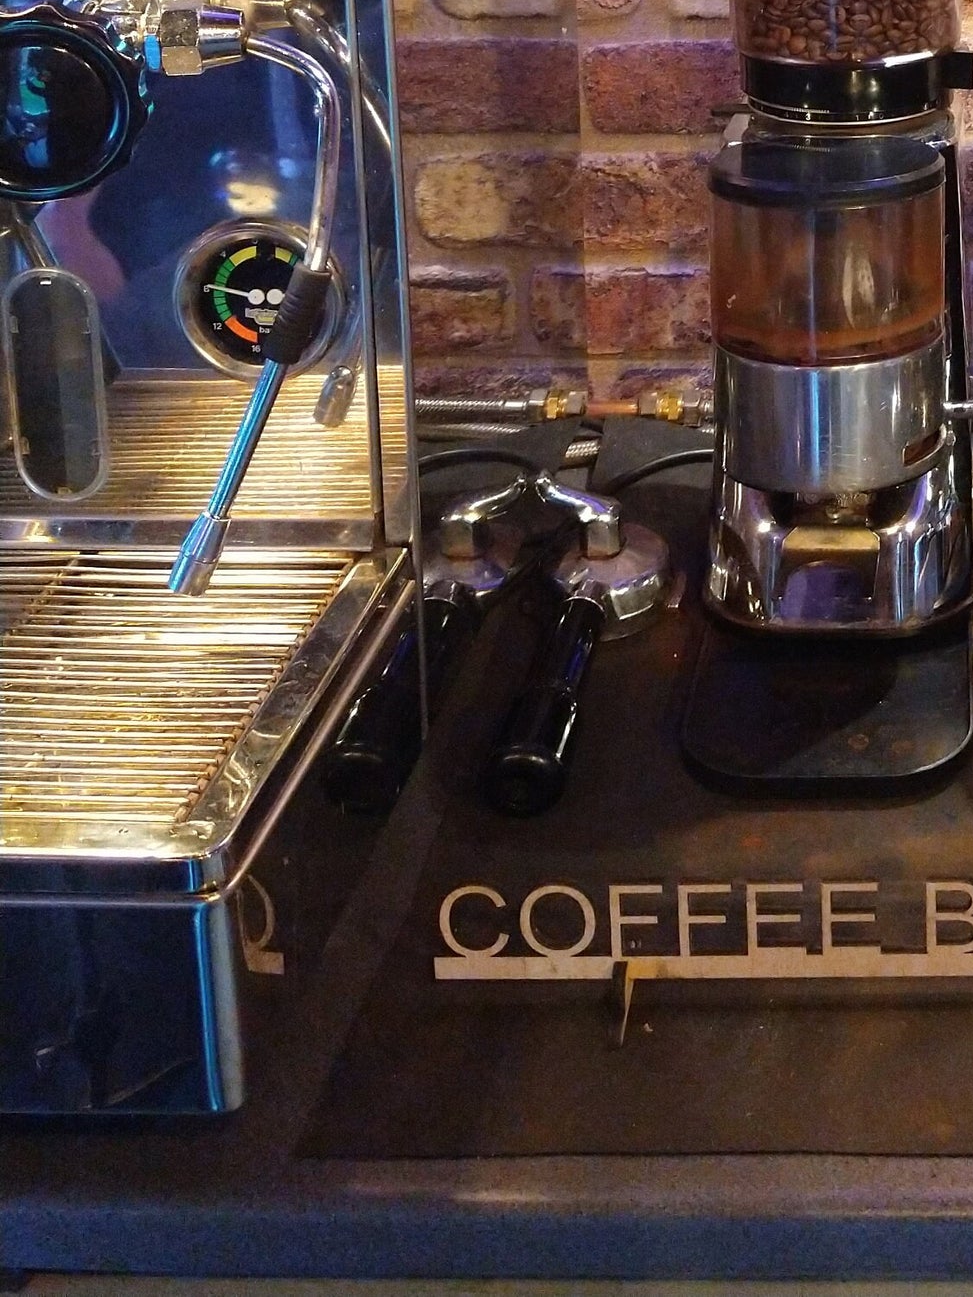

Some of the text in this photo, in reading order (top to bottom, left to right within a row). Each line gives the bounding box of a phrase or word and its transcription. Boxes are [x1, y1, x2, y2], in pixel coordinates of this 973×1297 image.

[213, 322, 223, 331] 12
[259, 326, 270, 334] ba
[251, 345, 261, 353] 16
[438, 881, 882, 958] COFFEE
